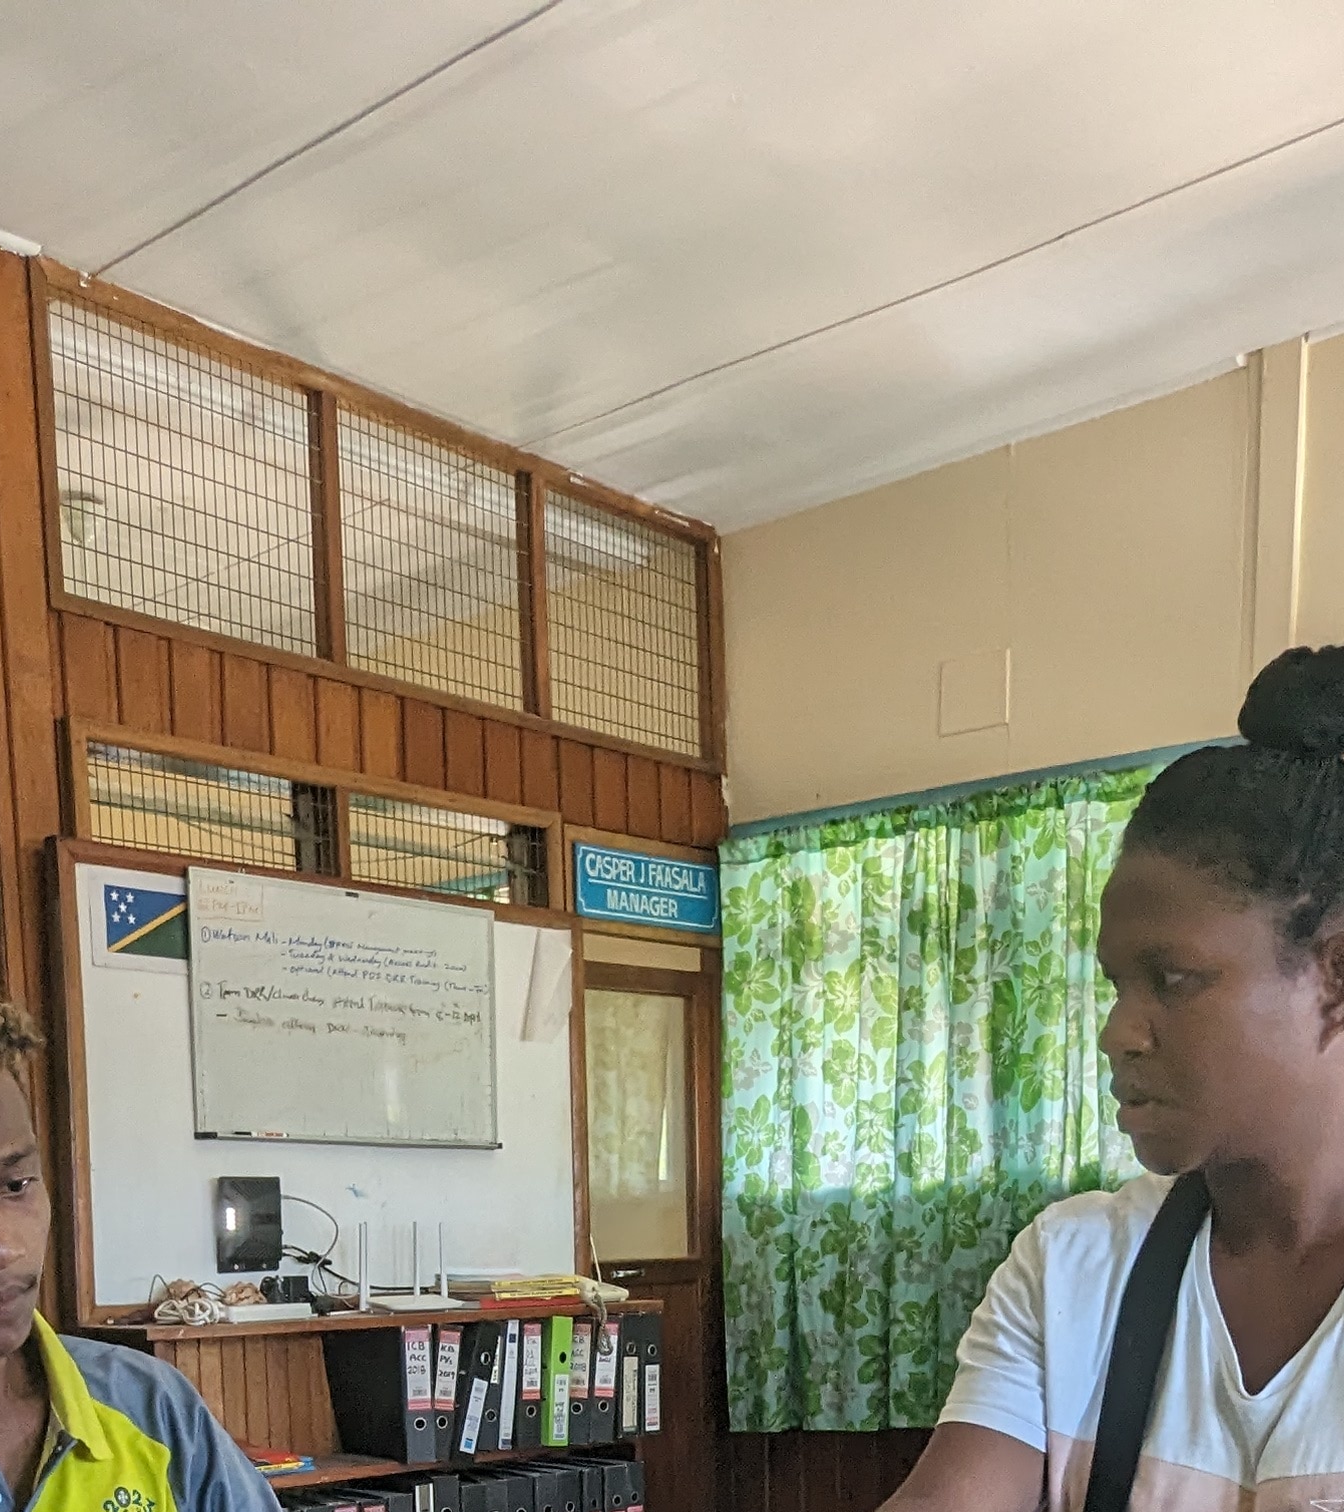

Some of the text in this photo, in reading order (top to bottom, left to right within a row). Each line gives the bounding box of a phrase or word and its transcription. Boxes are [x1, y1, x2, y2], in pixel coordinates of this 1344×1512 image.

[585, 853, 636, 883] CASPER
[640, 862, 645, 884] J
[607, 889, 678, 918] MANAGER
